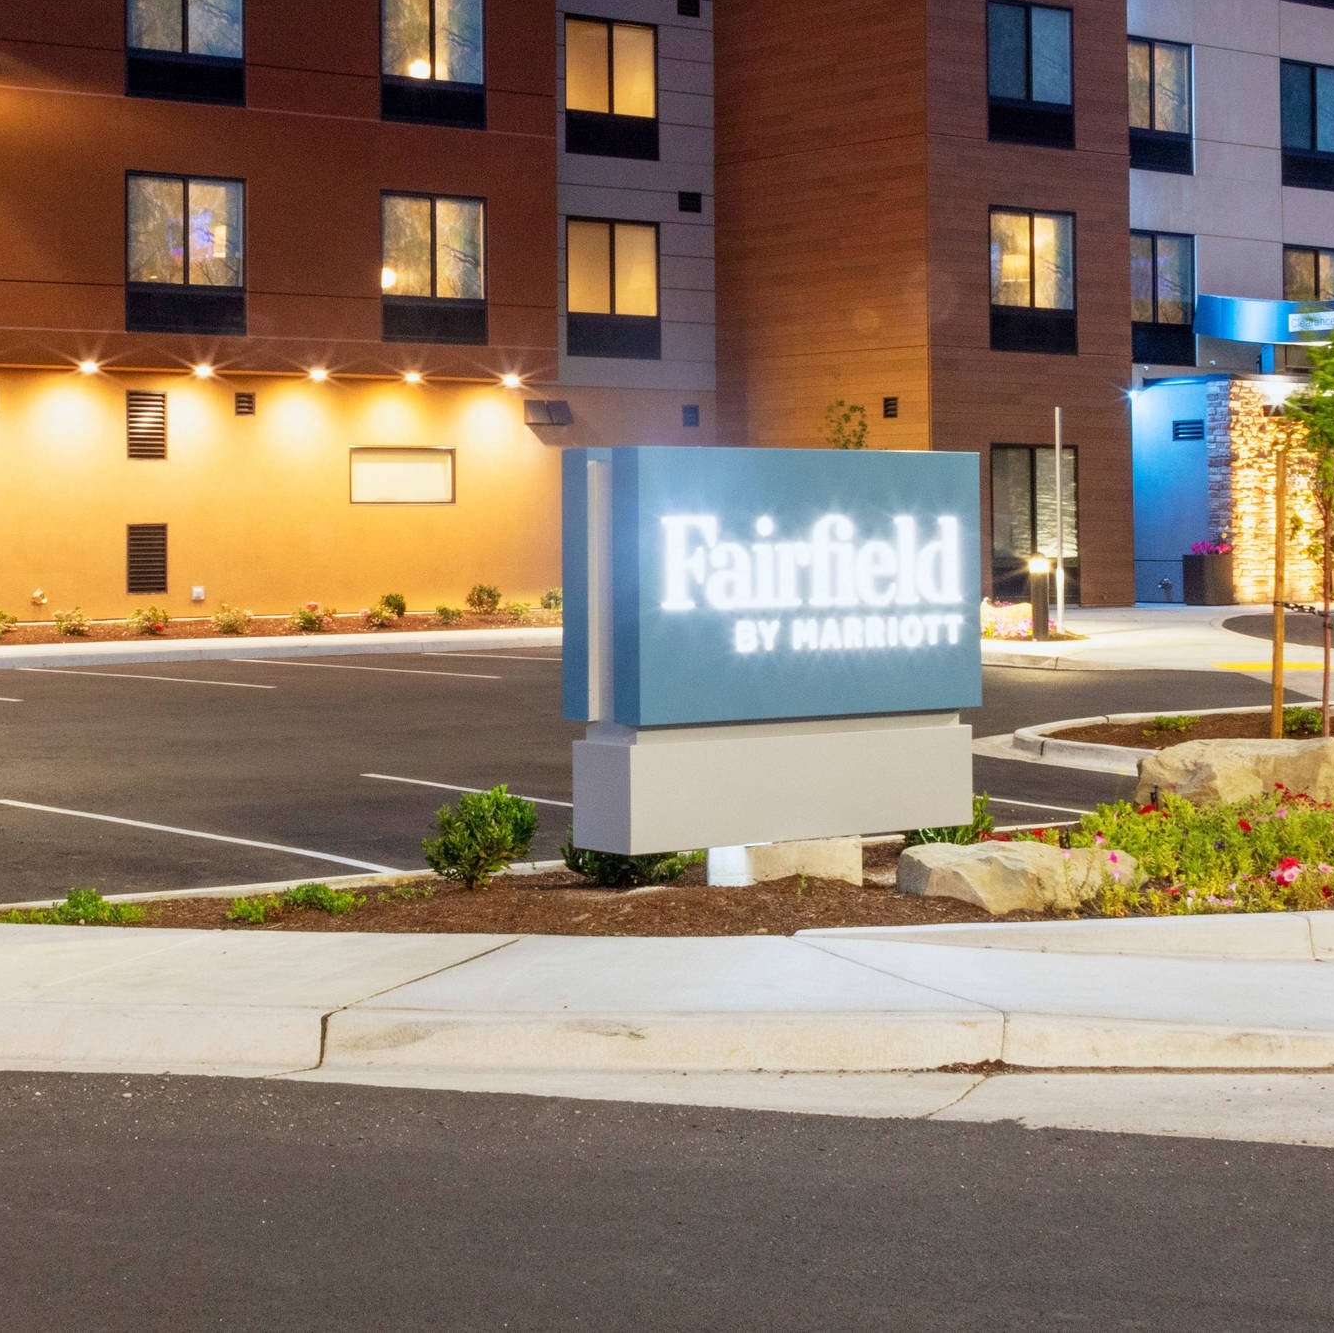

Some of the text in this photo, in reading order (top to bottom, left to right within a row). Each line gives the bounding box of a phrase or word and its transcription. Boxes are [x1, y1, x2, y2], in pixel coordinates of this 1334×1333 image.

[661, 513, 964, 611] Fairfield
[733, 614, 964, 654] BY MARRIOTT
